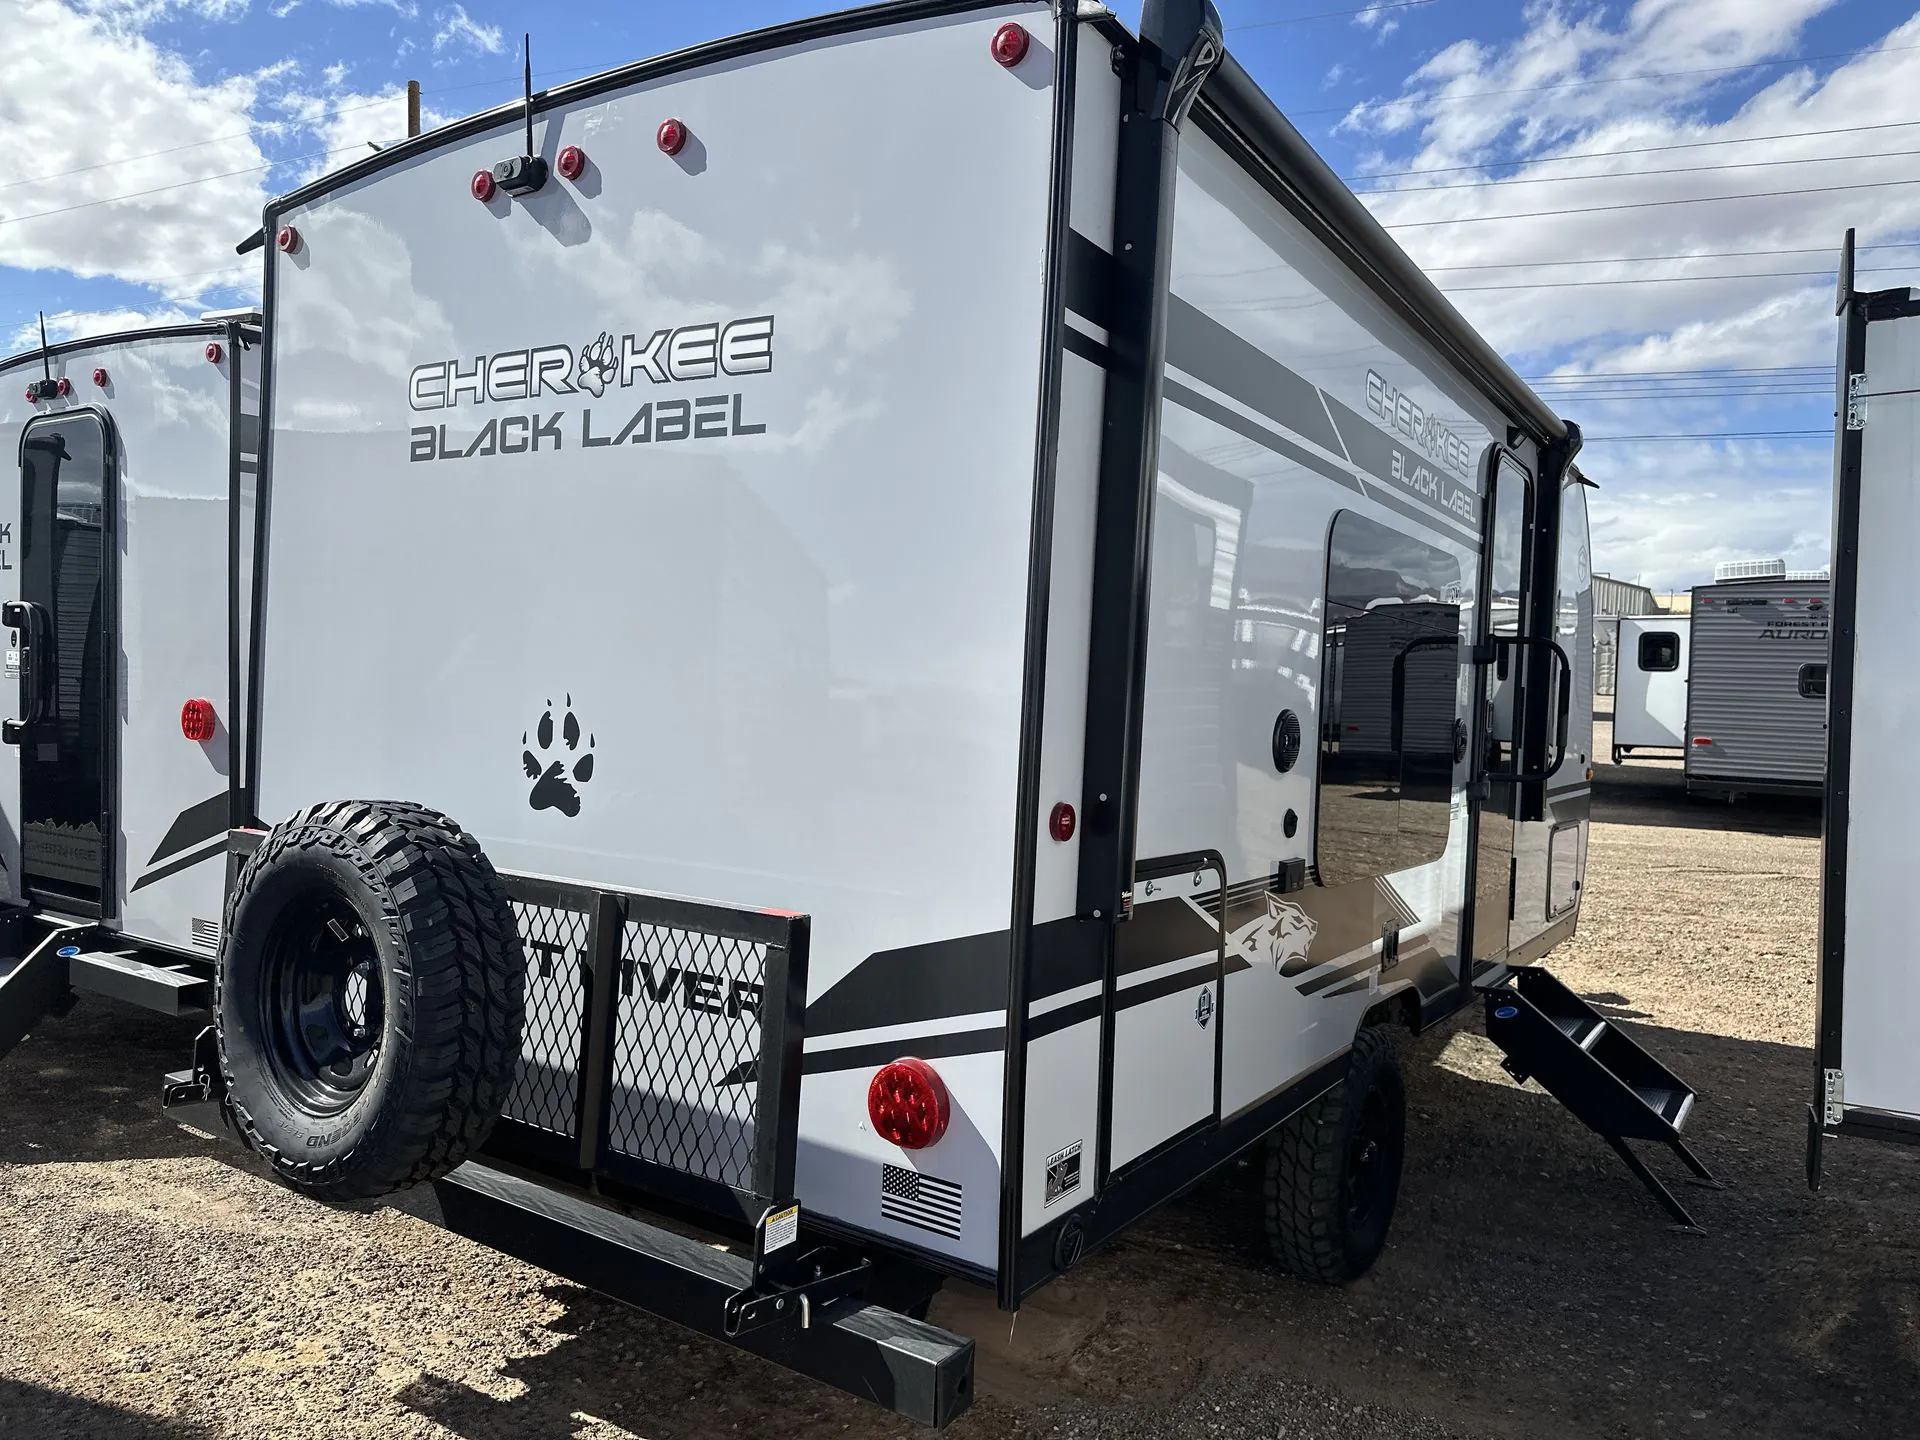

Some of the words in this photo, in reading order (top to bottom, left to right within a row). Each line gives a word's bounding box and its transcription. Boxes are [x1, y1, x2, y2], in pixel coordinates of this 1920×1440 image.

[410, 411, 566, 462] BLACK
[581, 393, 767, 449] LABEL
[1391, 449, 1439, 501] BLACK
[1440, 480, 1477, 524] LABEL
